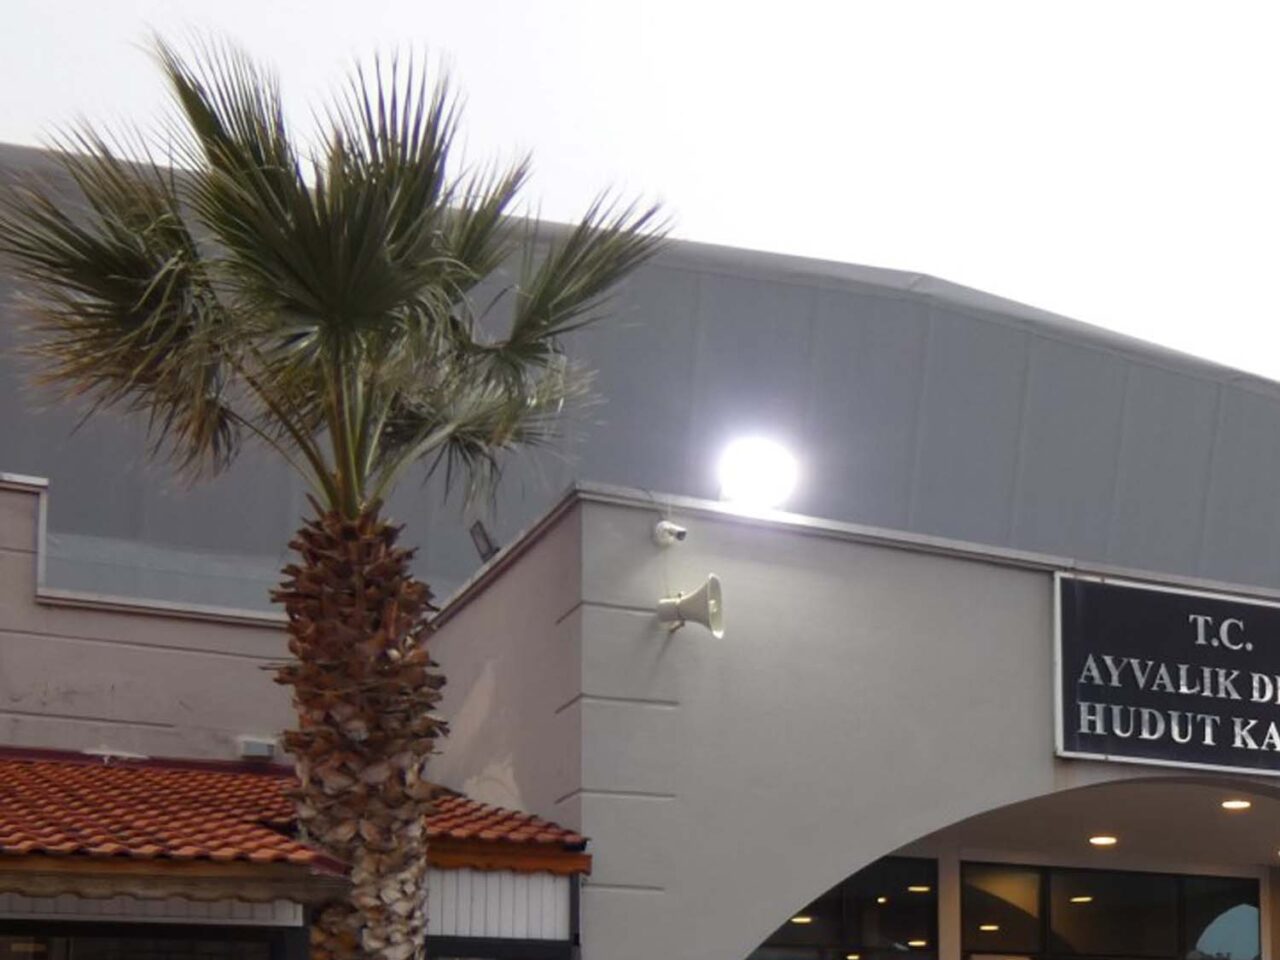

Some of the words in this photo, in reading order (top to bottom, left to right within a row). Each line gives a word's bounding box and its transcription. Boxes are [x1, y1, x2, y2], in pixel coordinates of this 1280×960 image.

[1189, 614, 1253, 651] T.C.
[1078, 653, 1241, 699] AYVALIK
[1077, 701, 1220, 746] HUDUT
